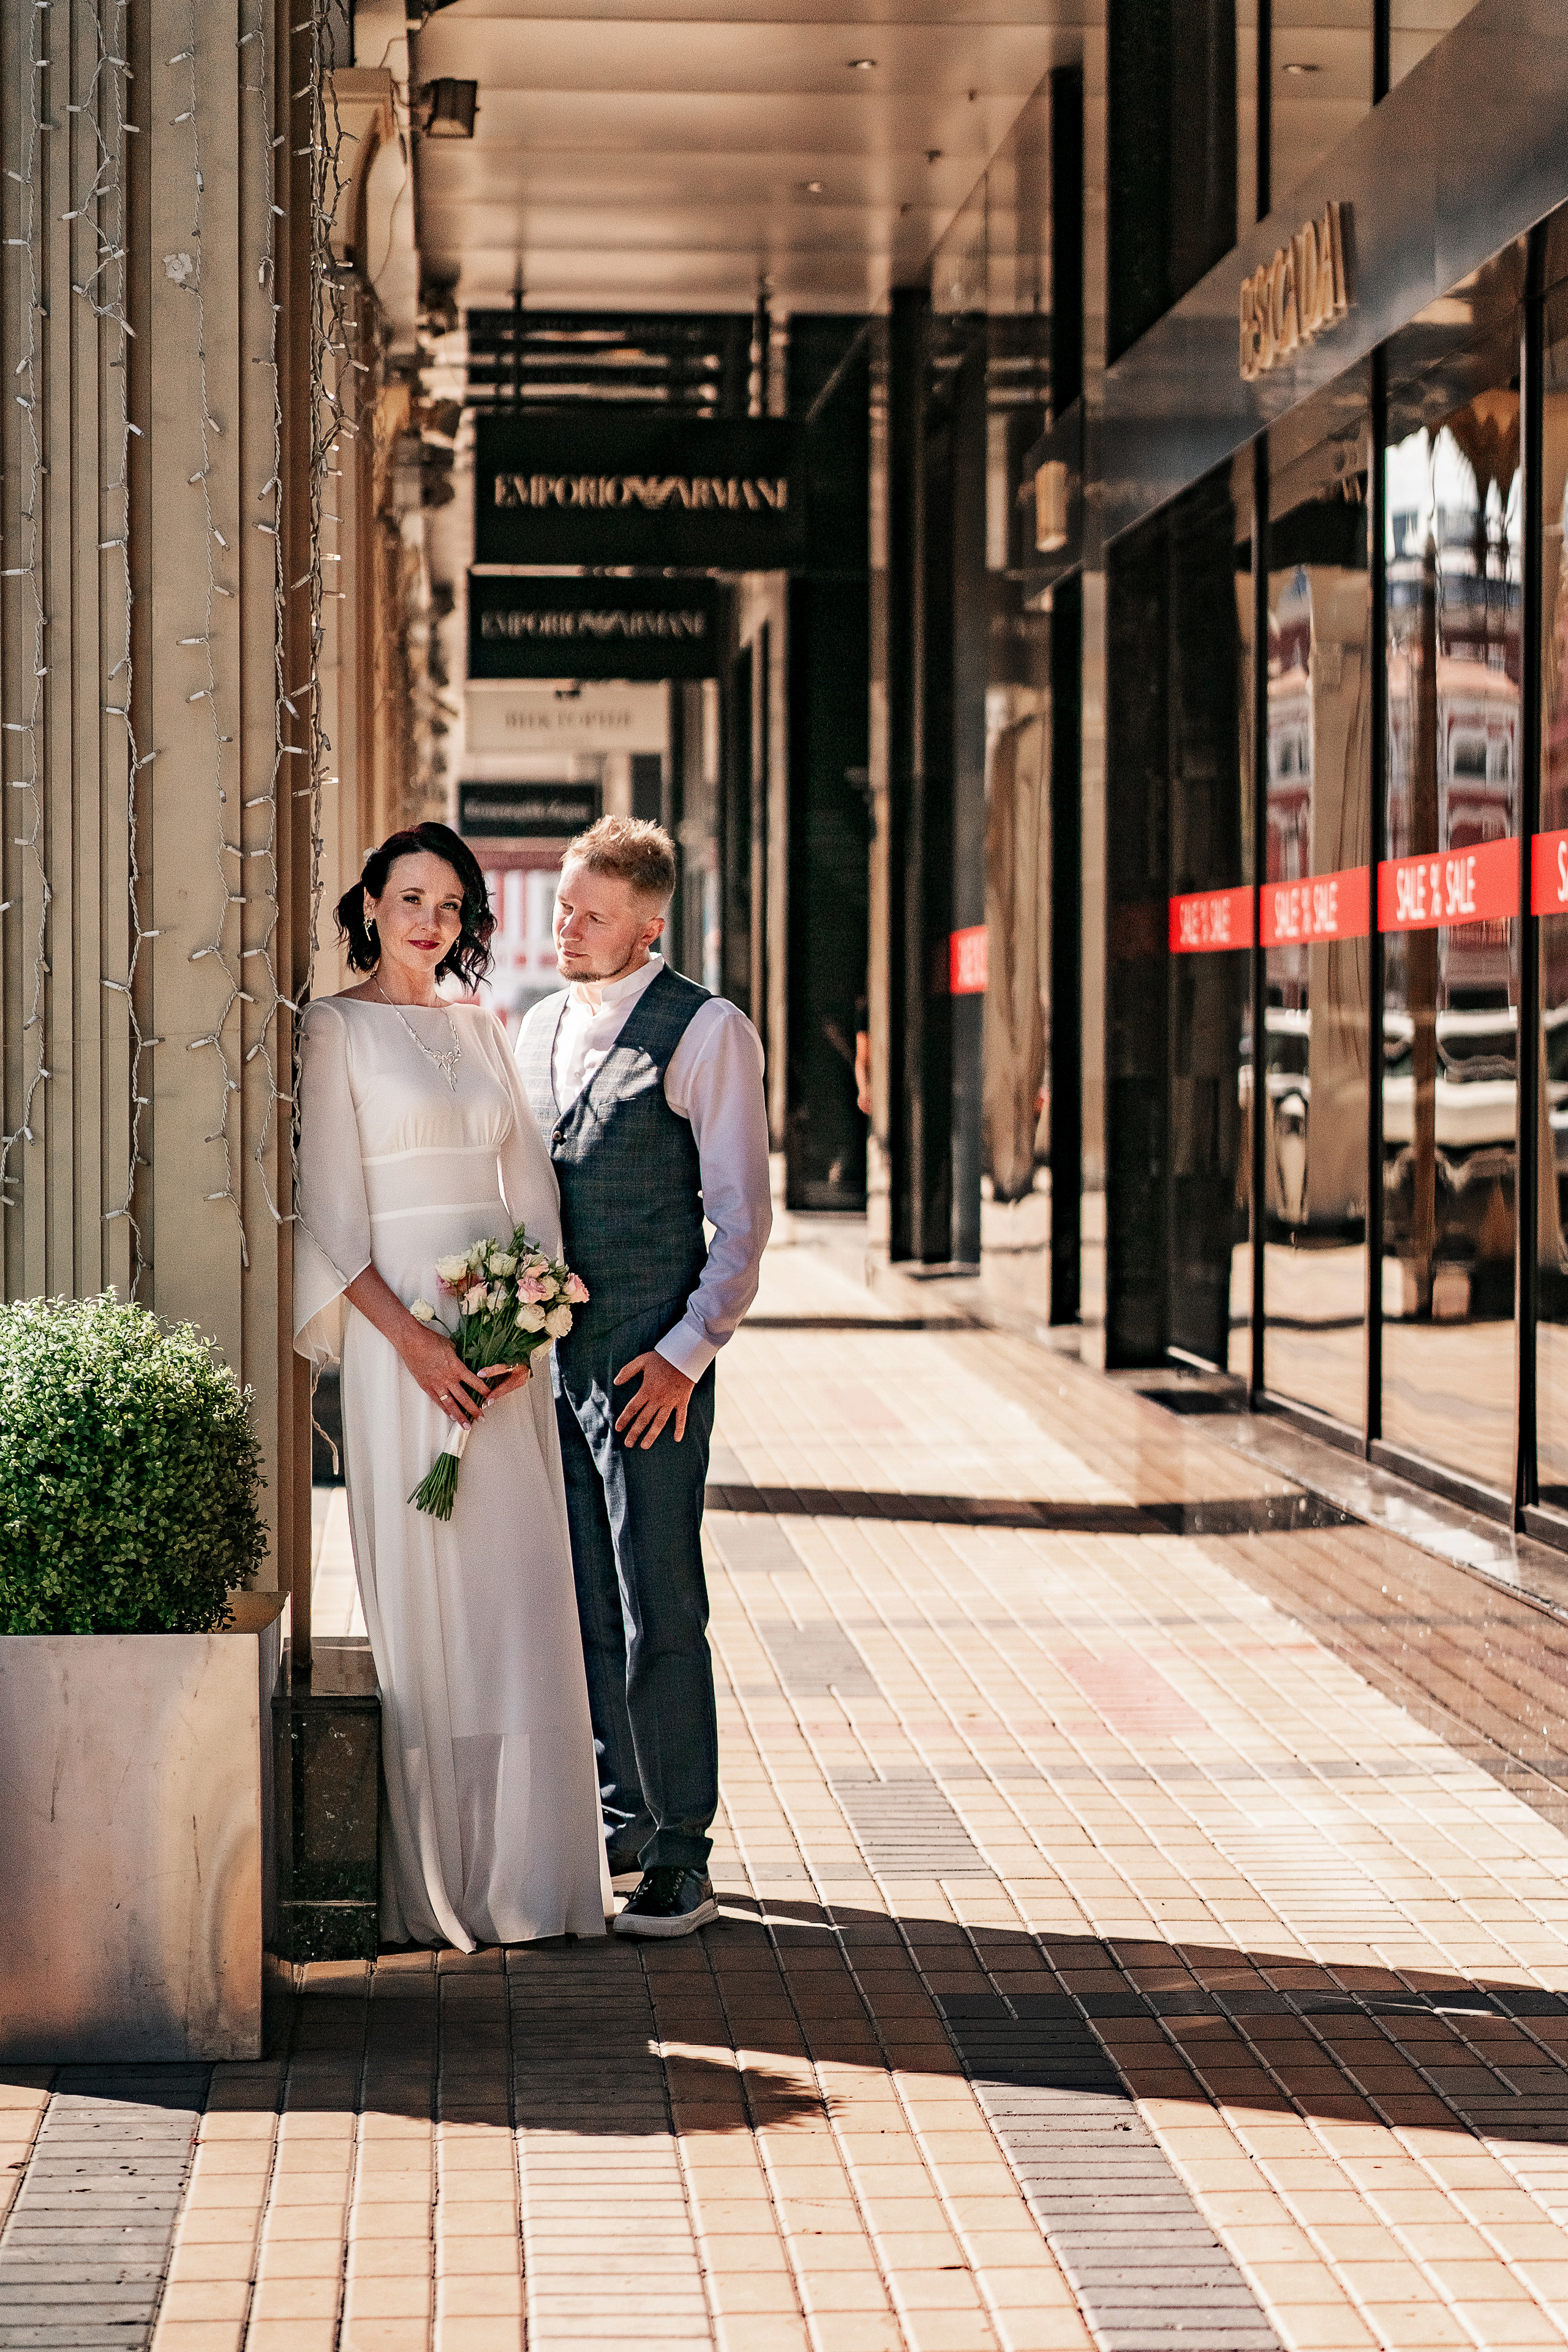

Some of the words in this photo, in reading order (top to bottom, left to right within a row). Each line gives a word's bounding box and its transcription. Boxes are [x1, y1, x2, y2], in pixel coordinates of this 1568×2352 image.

[1239, 199, 1348, 381] ESCADA
[494, 473, 630, 508] EMPORIO
[1396, 864, 1426, 922] SALE
[1446, 856, 1476, 917] SALE
